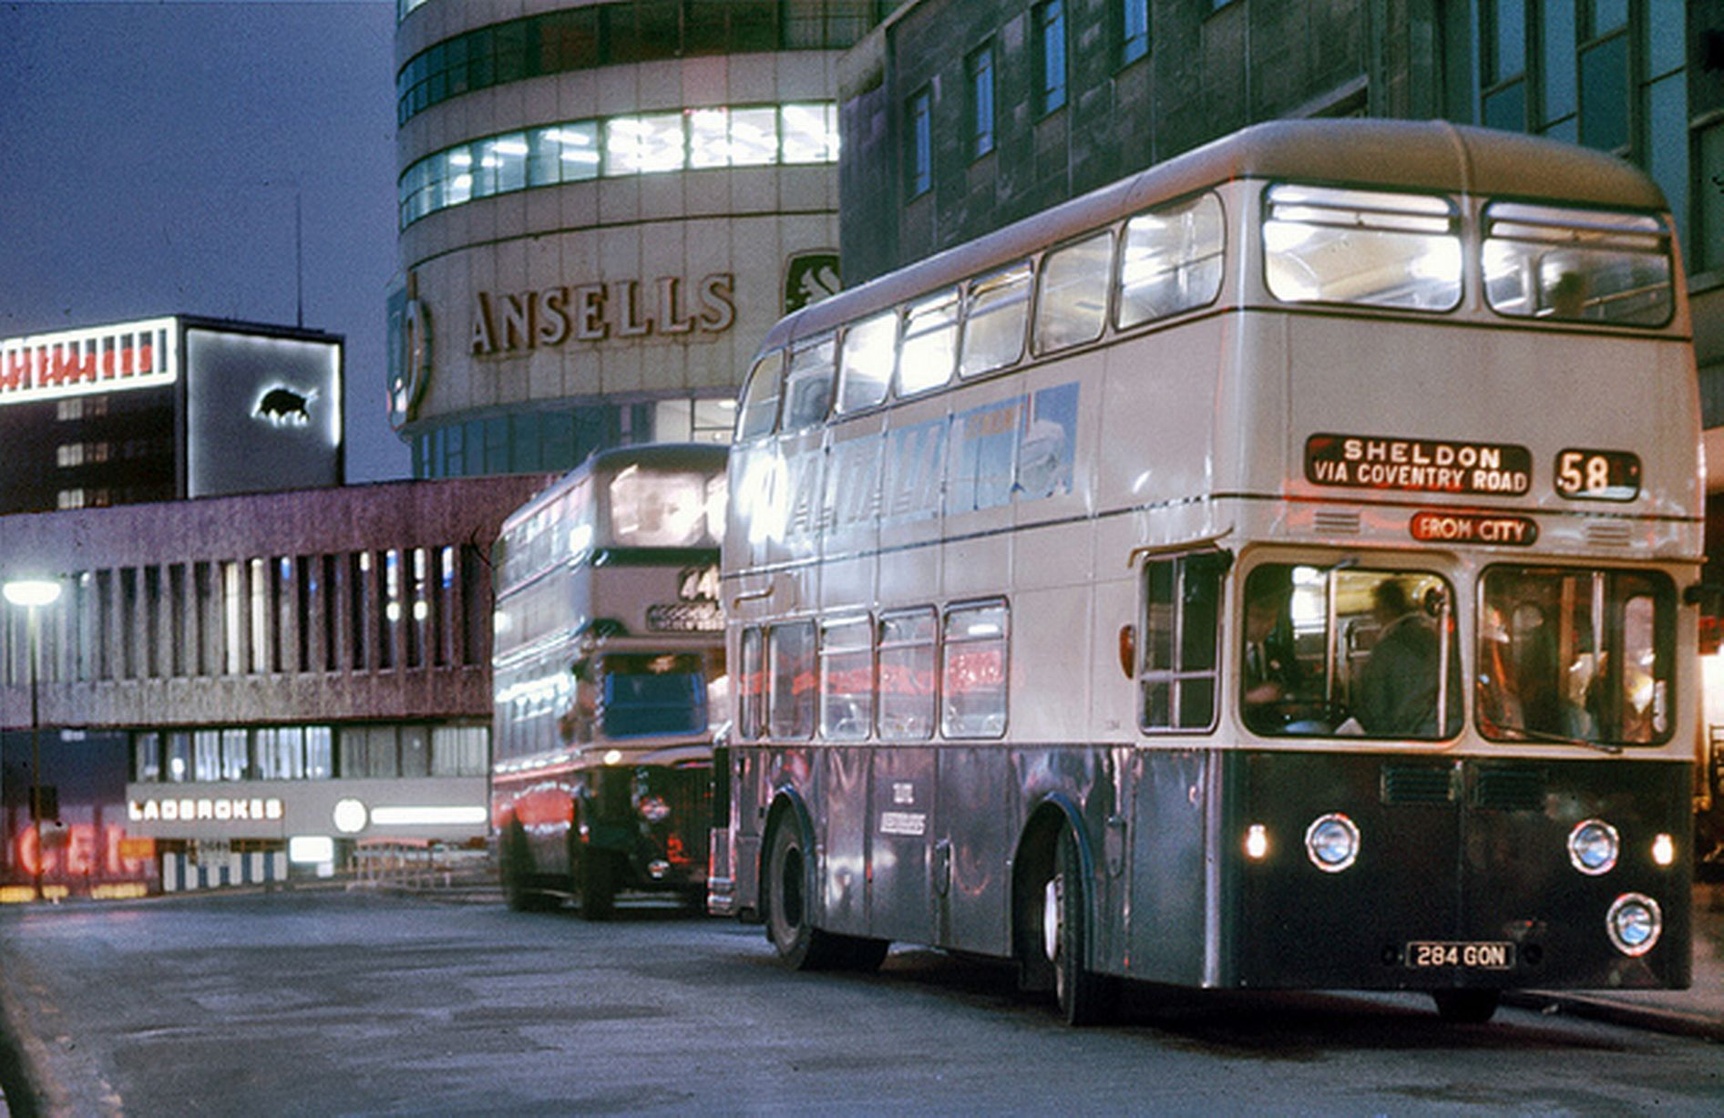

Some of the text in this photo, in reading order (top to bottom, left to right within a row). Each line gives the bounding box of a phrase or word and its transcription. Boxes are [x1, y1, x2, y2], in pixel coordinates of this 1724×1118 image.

[470, 272, 735, 355] ANSELLS
[1343, 438, 1501, 469] SHELDON
[1313, 461, 1528, 493] VIA COVENTRY ROAD
[1560, 451, 1608, 494] 58
[1478, 519, 1527, 542] CITY
[1417, 945, 1505, 966] 284 GON
